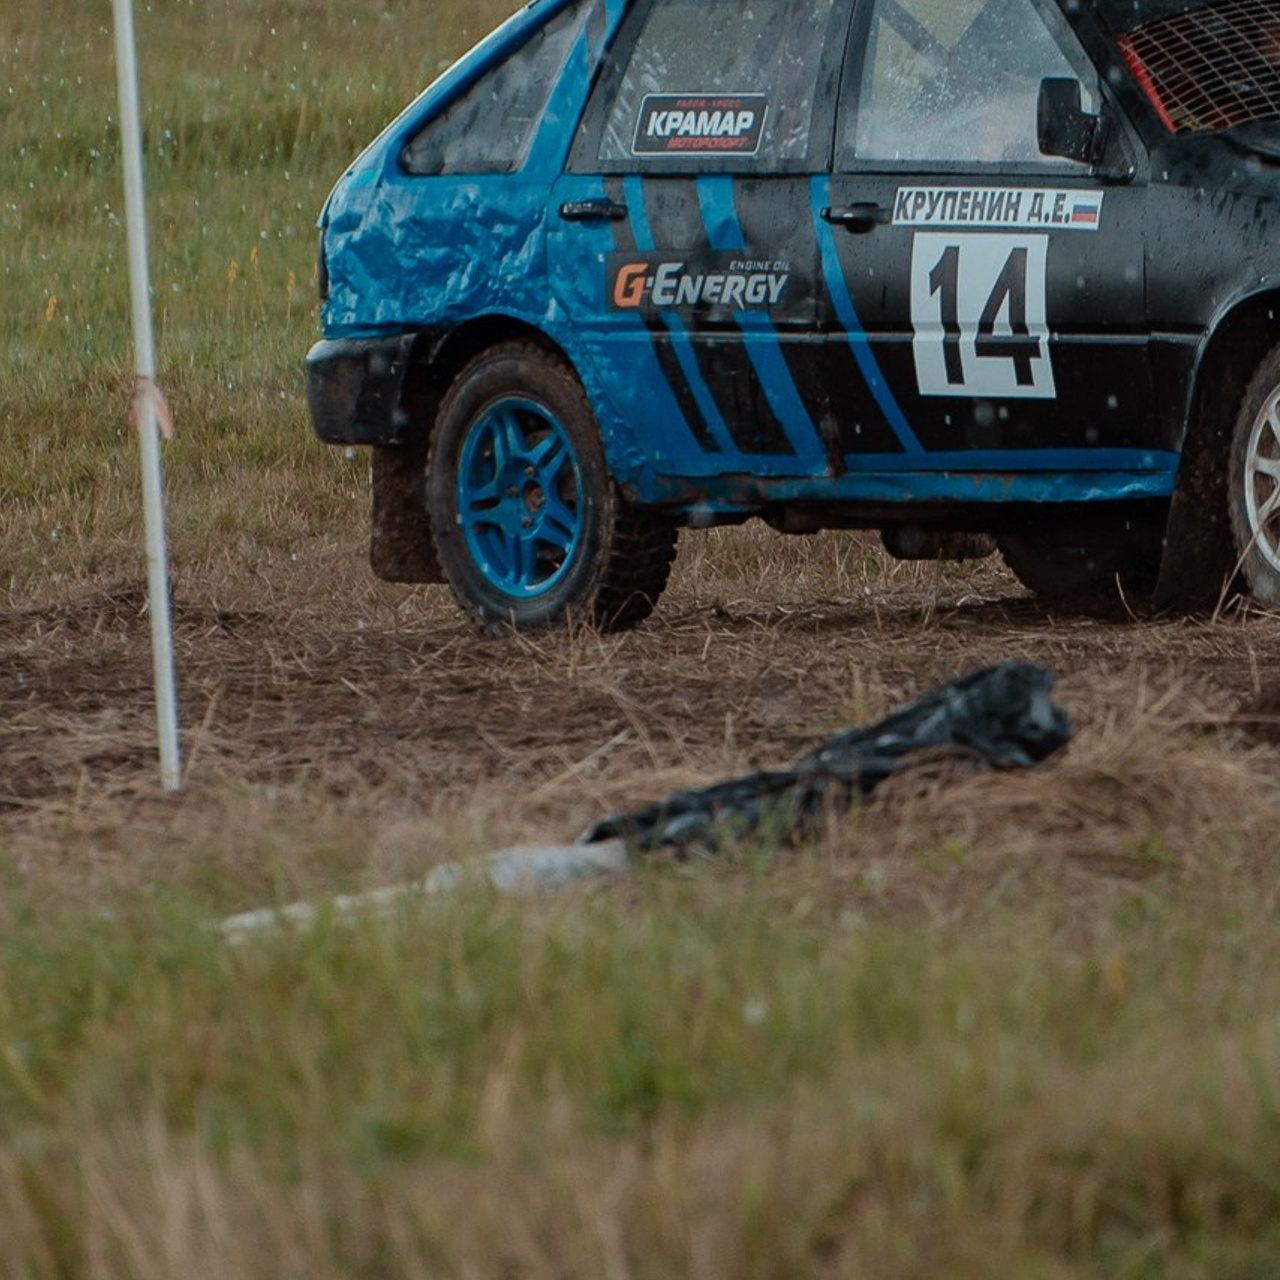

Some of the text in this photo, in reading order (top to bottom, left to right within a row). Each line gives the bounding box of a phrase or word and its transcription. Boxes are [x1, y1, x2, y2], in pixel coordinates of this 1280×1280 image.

[646, 110, 755, 136] КРАМАР
[895, 190, 1071, 224] КРУПЕНИН Д.Е.
[729, 259, 791, 271] ENGINE OIL
[928, 245, 1042, 387] 14
